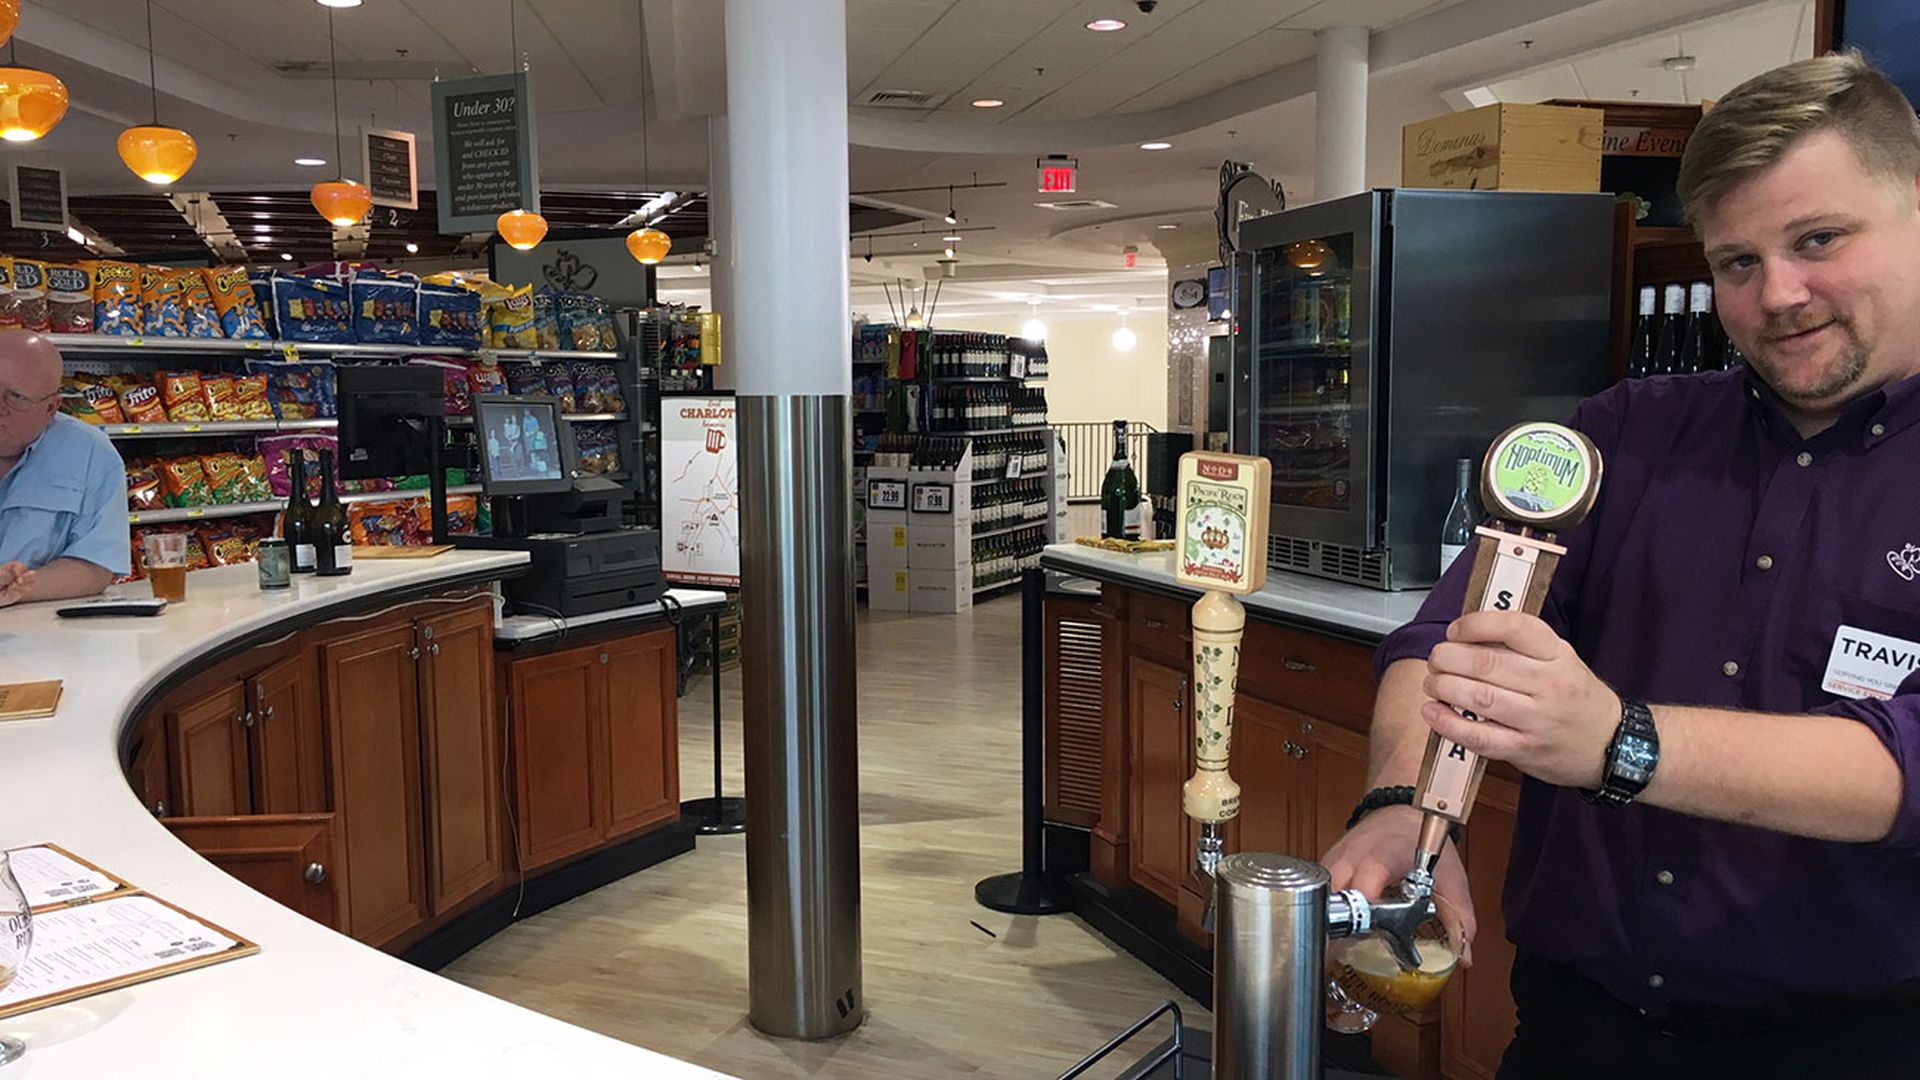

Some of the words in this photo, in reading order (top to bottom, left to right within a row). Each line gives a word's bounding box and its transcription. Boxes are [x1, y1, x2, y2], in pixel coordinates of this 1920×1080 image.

[453, 100, 491, 118] Under
[492, 97, 516, 115] 30?
[1416, 128, 1486, 157] Dominus
[1044, 167, 1072, 192] EXIT
[388, 209, 399, 228] 2
[40, 230, 50, 249] 3
[47, 277, 86, 290] GOLD
[50, 269, 83, 279] ROLD
